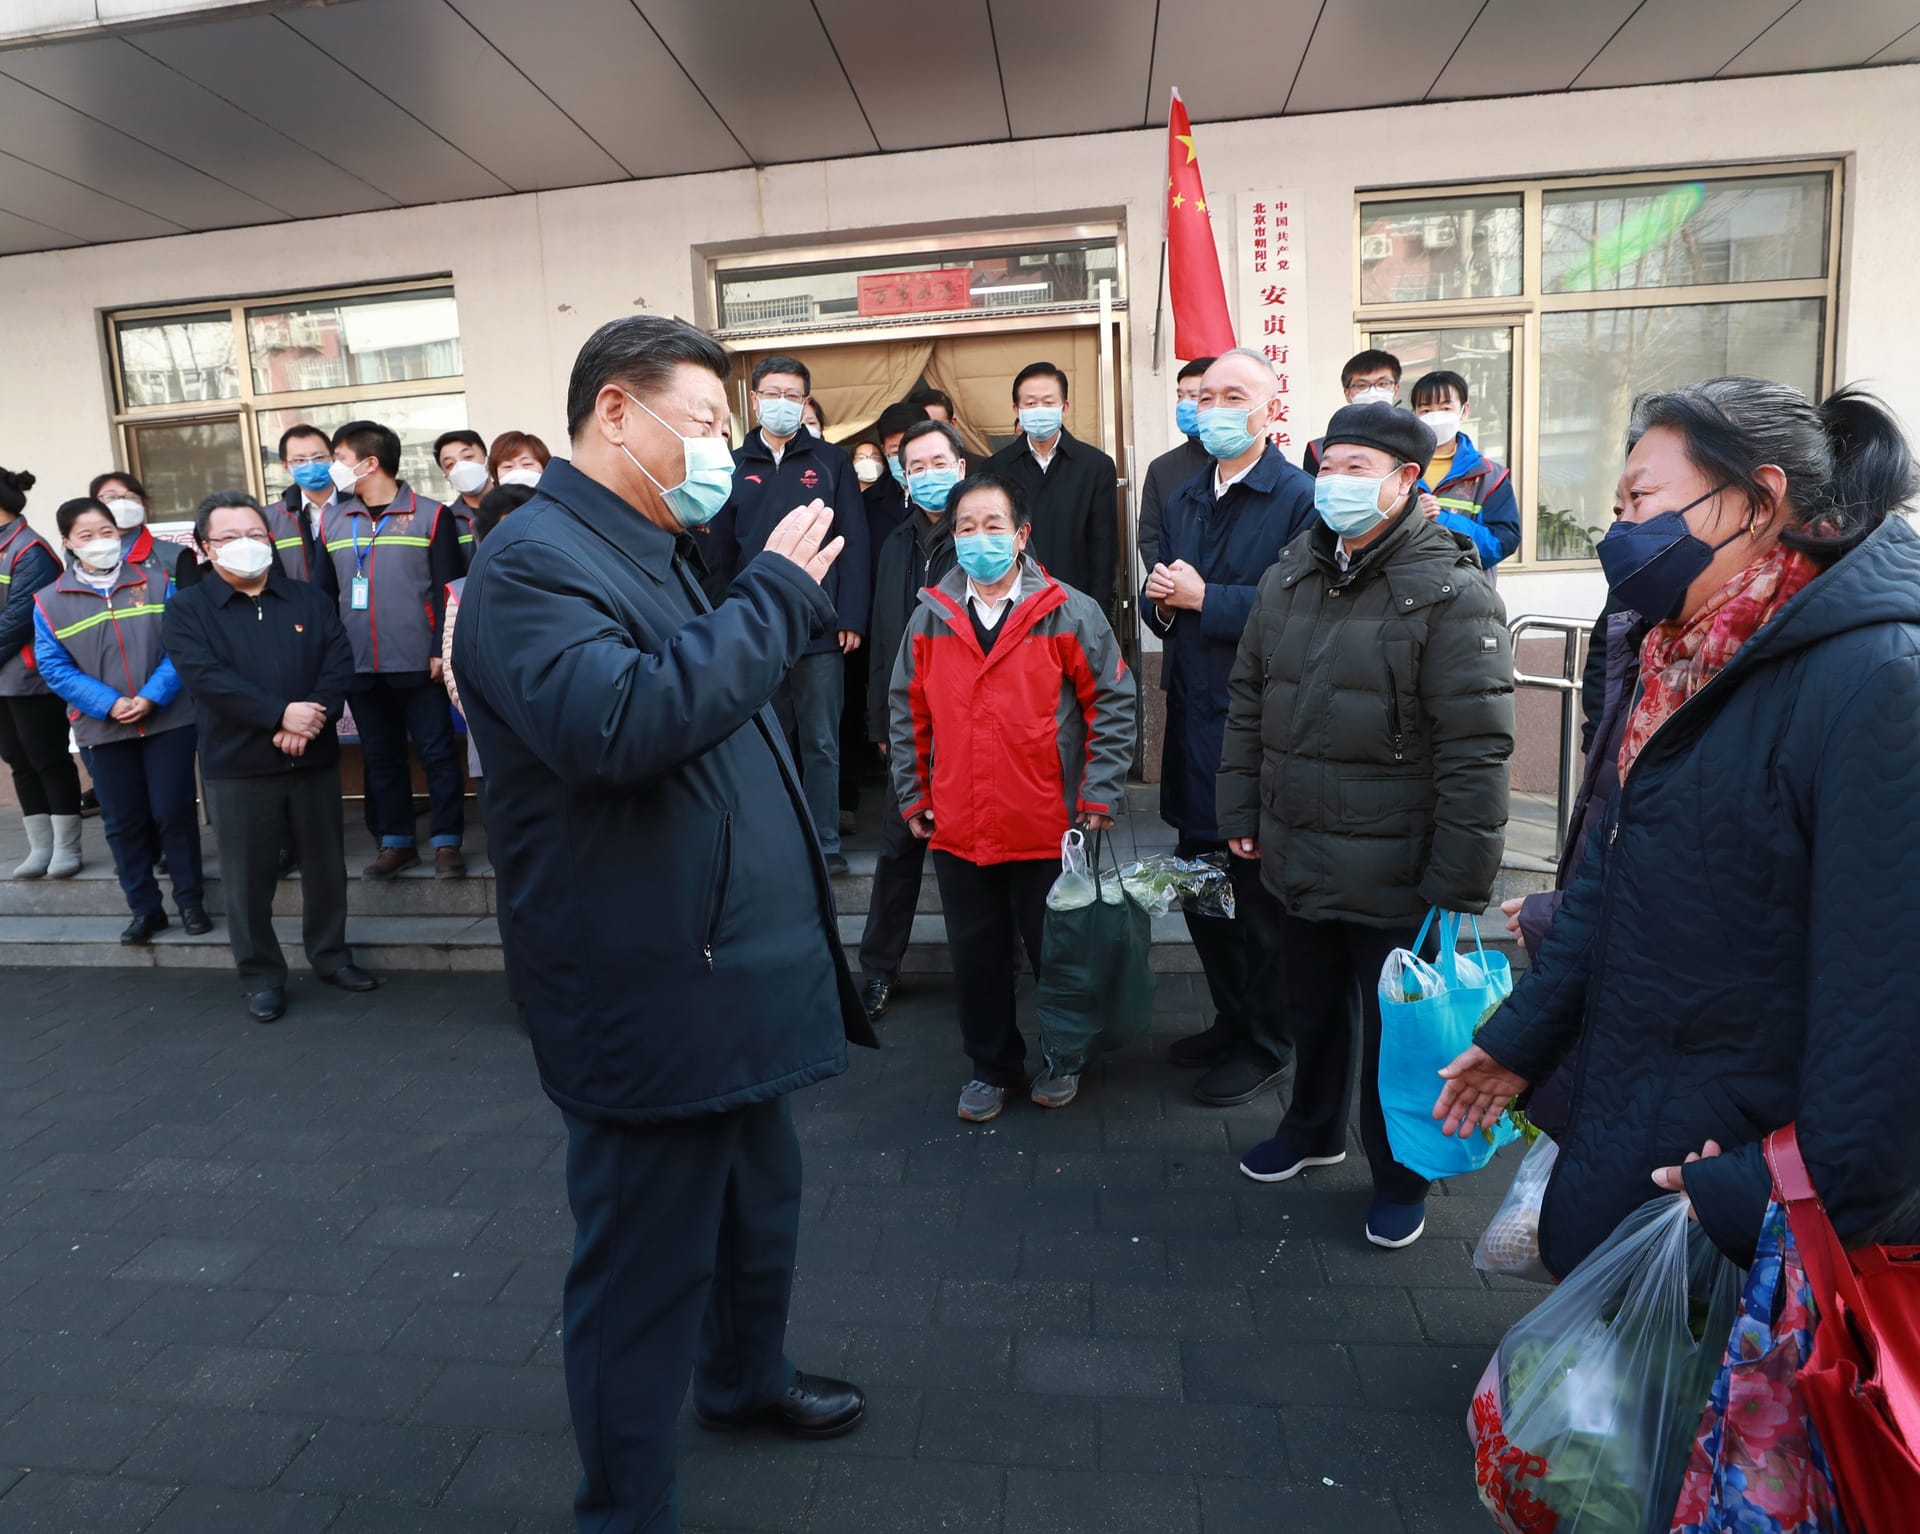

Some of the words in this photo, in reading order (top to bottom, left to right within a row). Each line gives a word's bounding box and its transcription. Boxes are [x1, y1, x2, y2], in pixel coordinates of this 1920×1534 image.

[1253, 202, 1267, 272] 北京市朝阳区
[1275, 200, 1289, 270] 中国共产党
